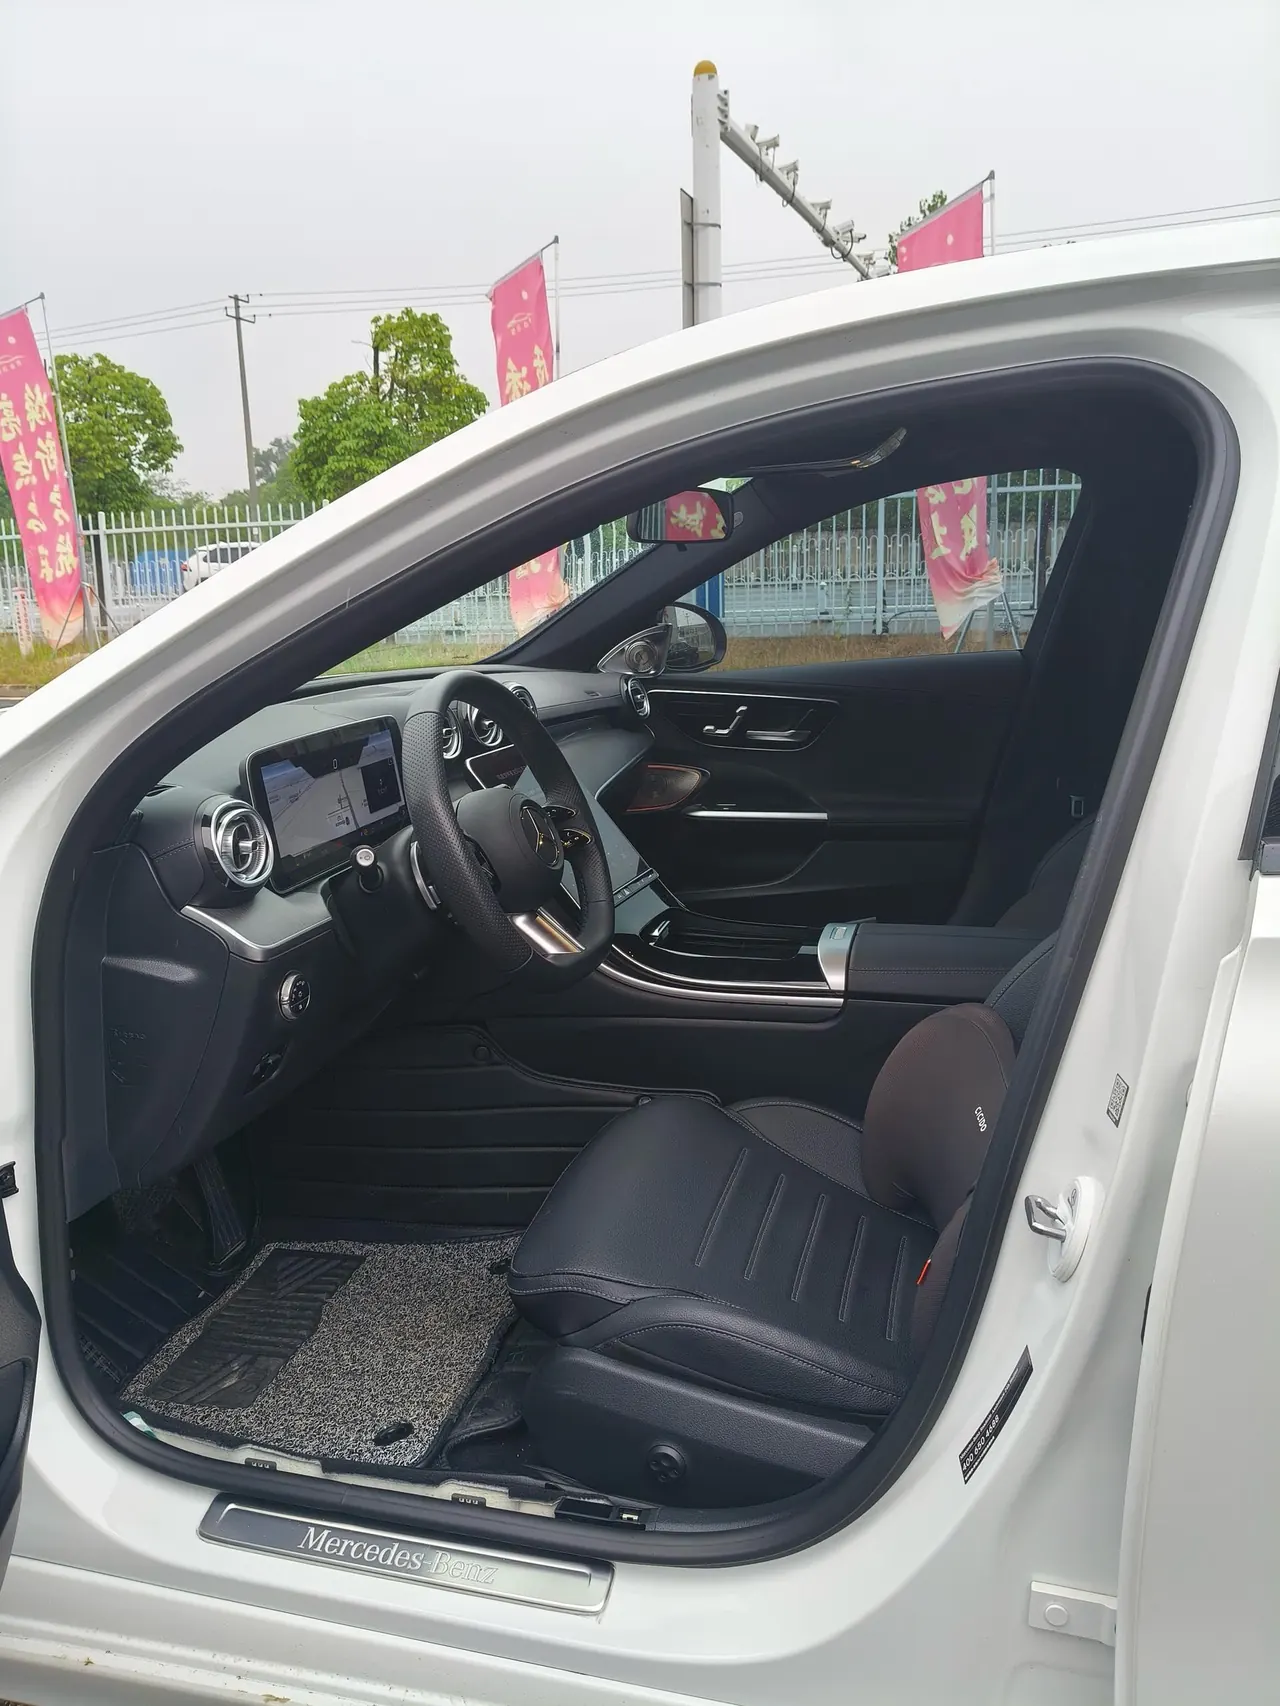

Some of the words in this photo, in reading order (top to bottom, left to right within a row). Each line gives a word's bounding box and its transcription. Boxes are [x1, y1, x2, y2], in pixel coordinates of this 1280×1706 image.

[961, 1450, 974, 1473] 400
[973, 1433, 985, 1457] 650
[984, 1412, 999, 1440] 4688
[297, 1526, 498, 1584] Mercedes-Benz
